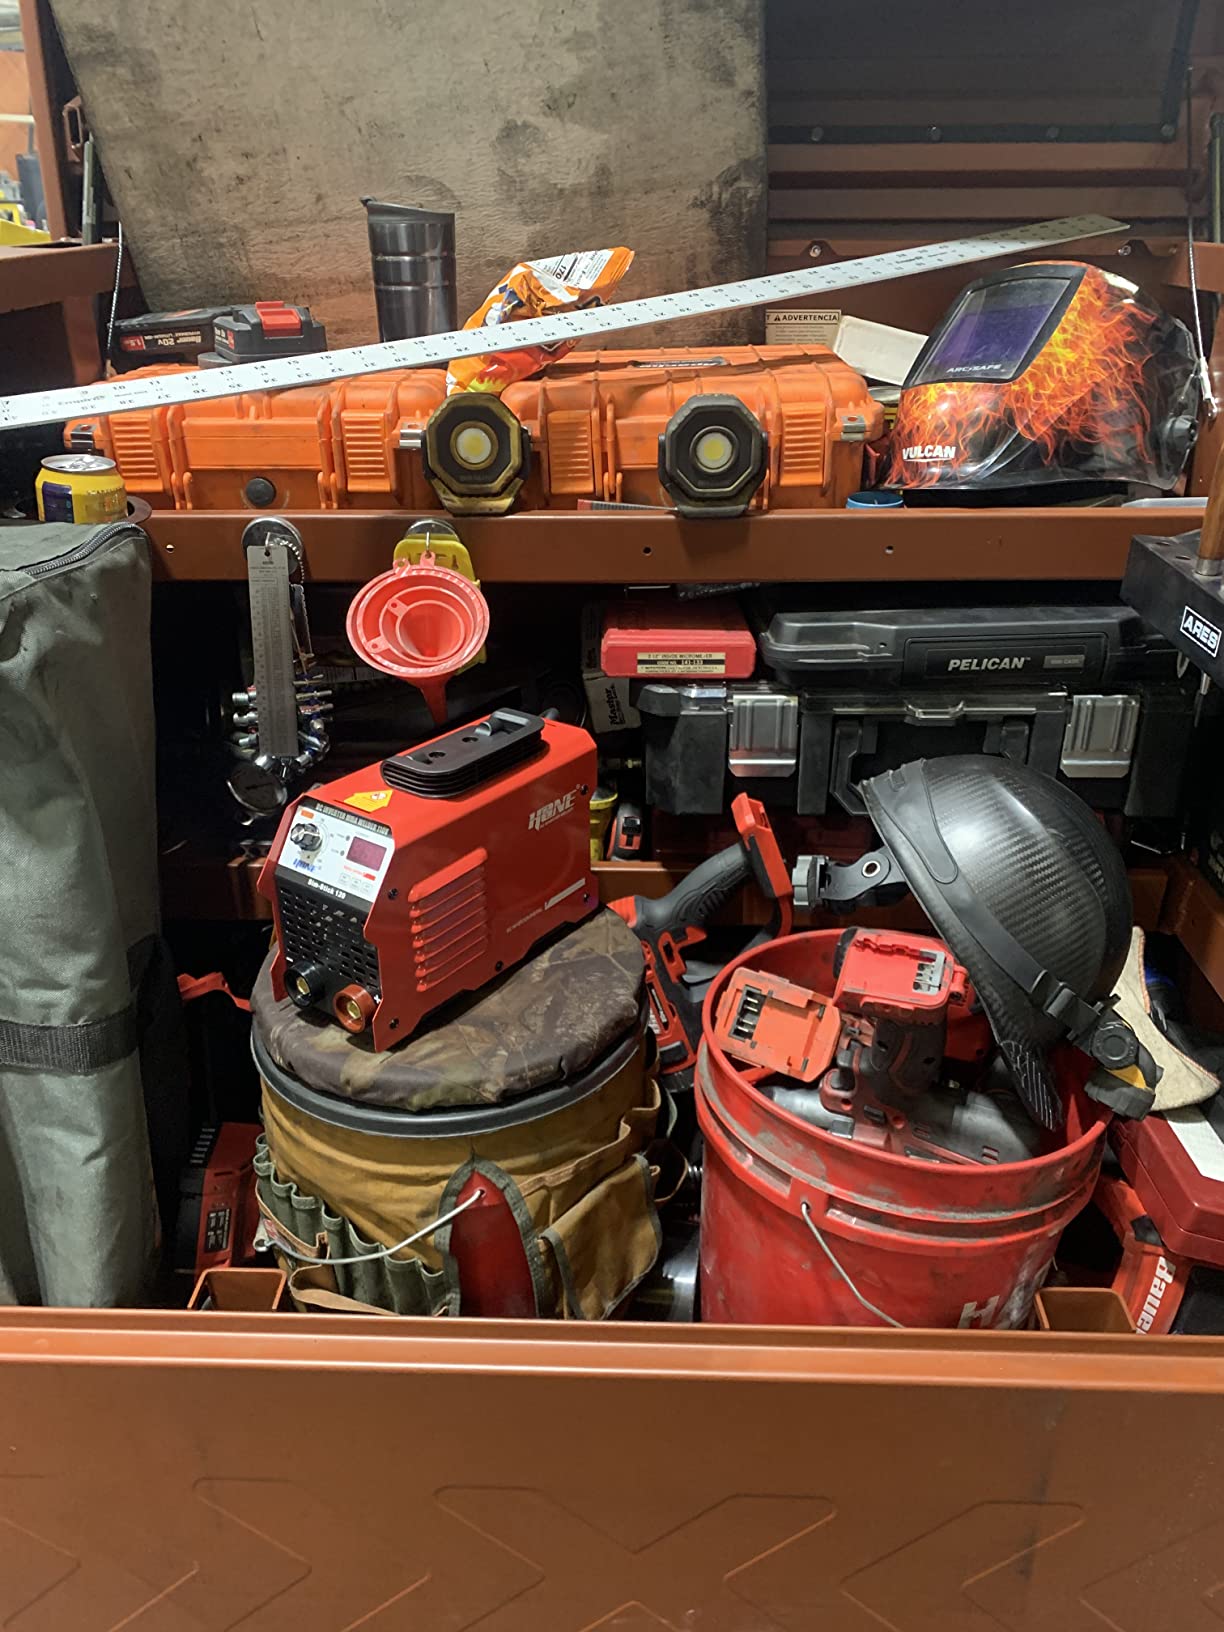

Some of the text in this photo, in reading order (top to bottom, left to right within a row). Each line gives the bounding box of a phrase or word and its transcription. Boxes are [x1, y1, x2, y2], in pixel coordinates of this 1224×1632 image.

[555, 264, 567, 280] 170
[902, 444, 957, 460] VULCAN
[1183, 615, 1219, 650] ARES
[948, 657, 1025, 671] PELICAN
[605, 686, 616, 725] Master
